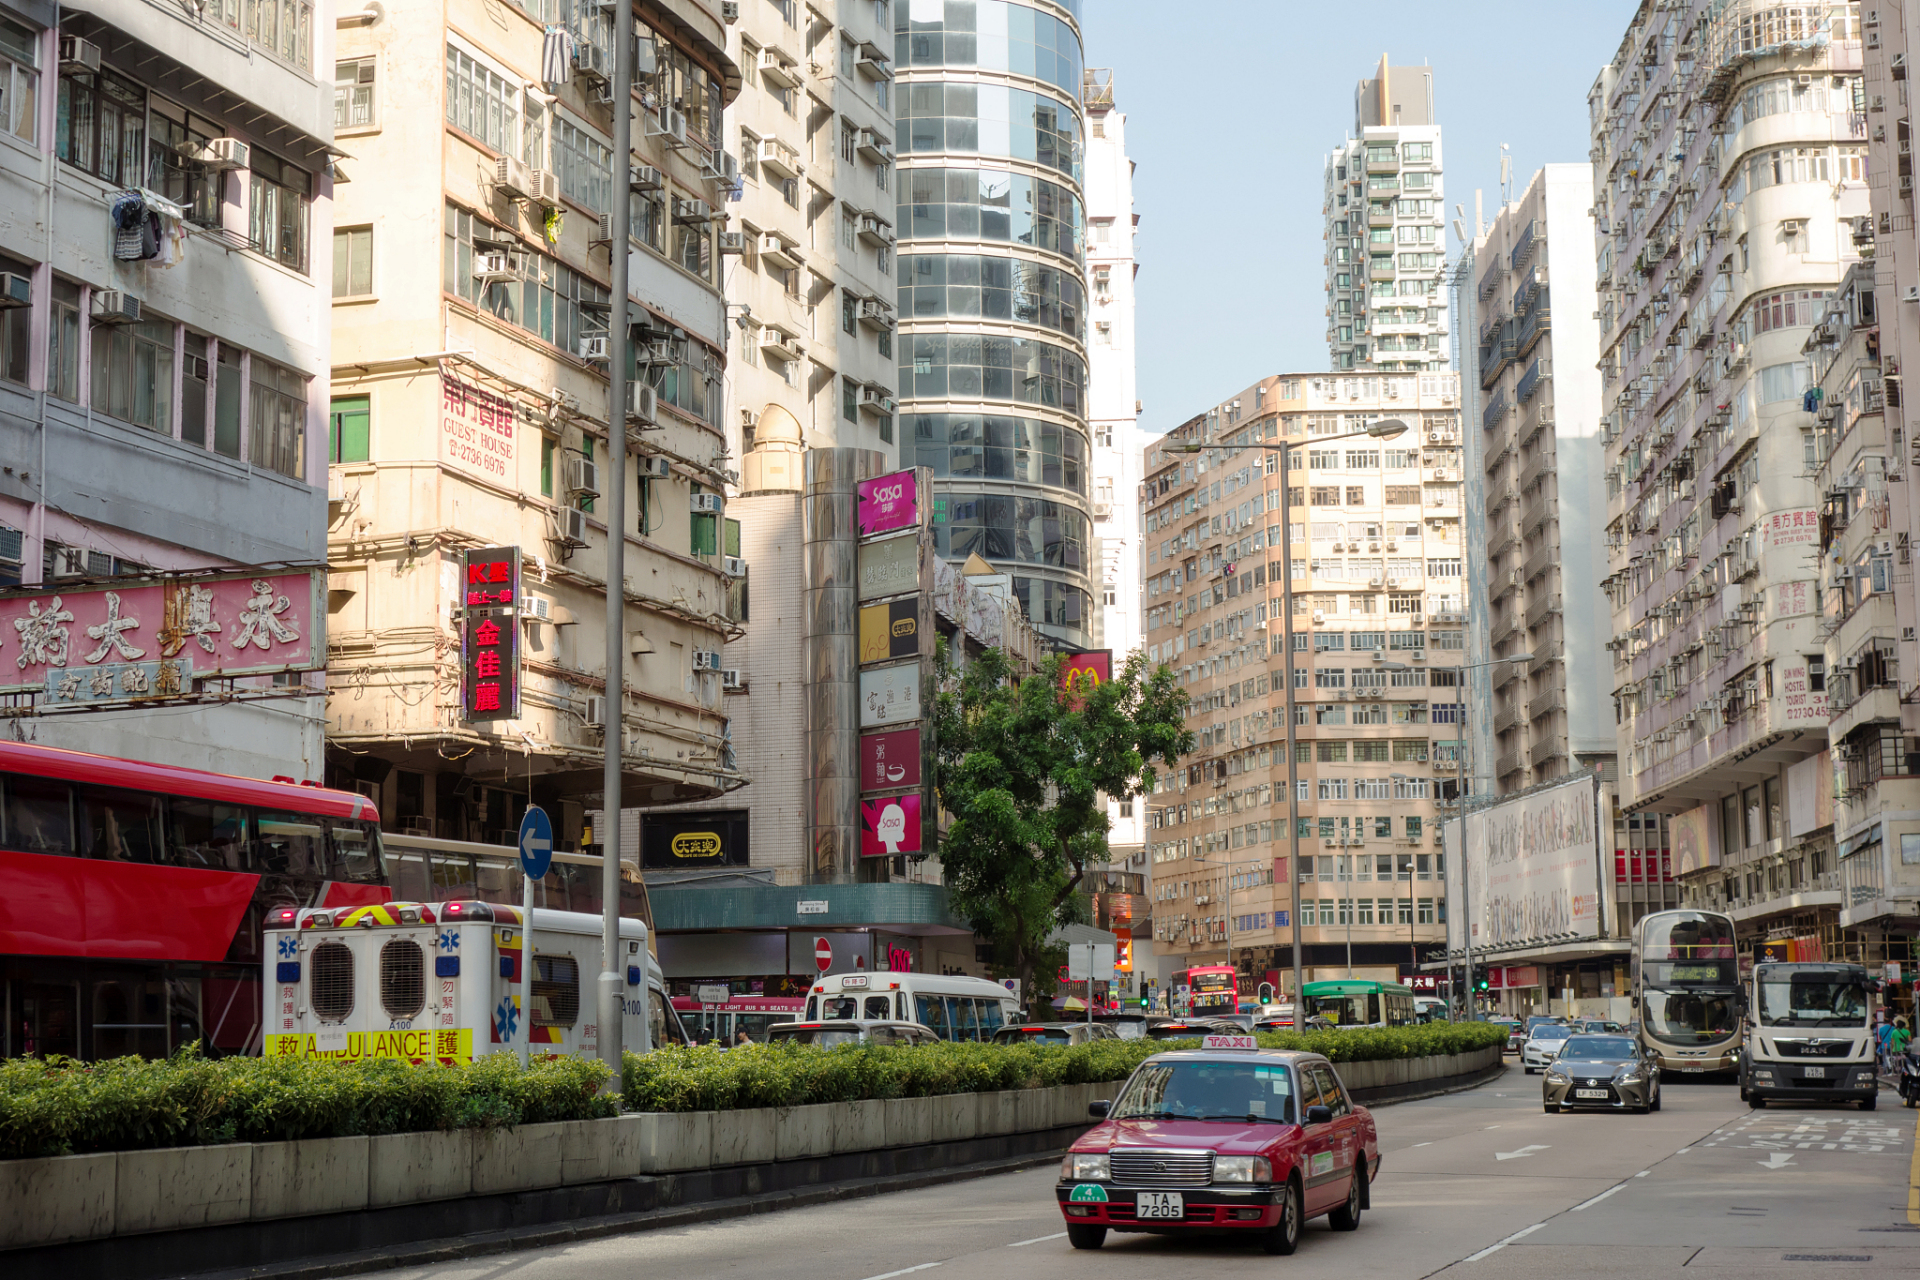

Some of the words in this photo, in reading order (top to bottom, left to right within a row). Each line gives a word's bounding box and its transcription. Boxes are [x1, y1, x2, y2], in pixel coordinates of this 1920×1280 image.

[443, 417, 477, 444] GUEST
[480, 432, 513, 460] HOUSE
[483, 454, 505, 477] 6976
[1772, 510, 1817, 530] 南方賓館
[1796, 534, 1812, 542] 6976
[474, 619, 501, 712] 金佳麗
[1785, 681, 1806, 693] HOSTEL
[1785, 694, 1807, 706] TOURIST
[1705, 967, 1718, 978] 95
[1403, 977, 1435, 988] 周大福
[282, 986, 294, 1030] 救護車
[442, 980, 454, 1026] 勿緊隨
[388, 1021, 412, 1031] A100
[278, 1036, 298, 1058] 救
[304, 1032, 432, 1059] AULANCE
[437, 1032, 458, 1055] 護
[1207, 1036, 1252, 1048] TAXI
[1084, 1188, 1093, 1196] 4
[1151, 1193, 1170, 1206] TA
[1141, 1205, 1180, 1217] 7205
